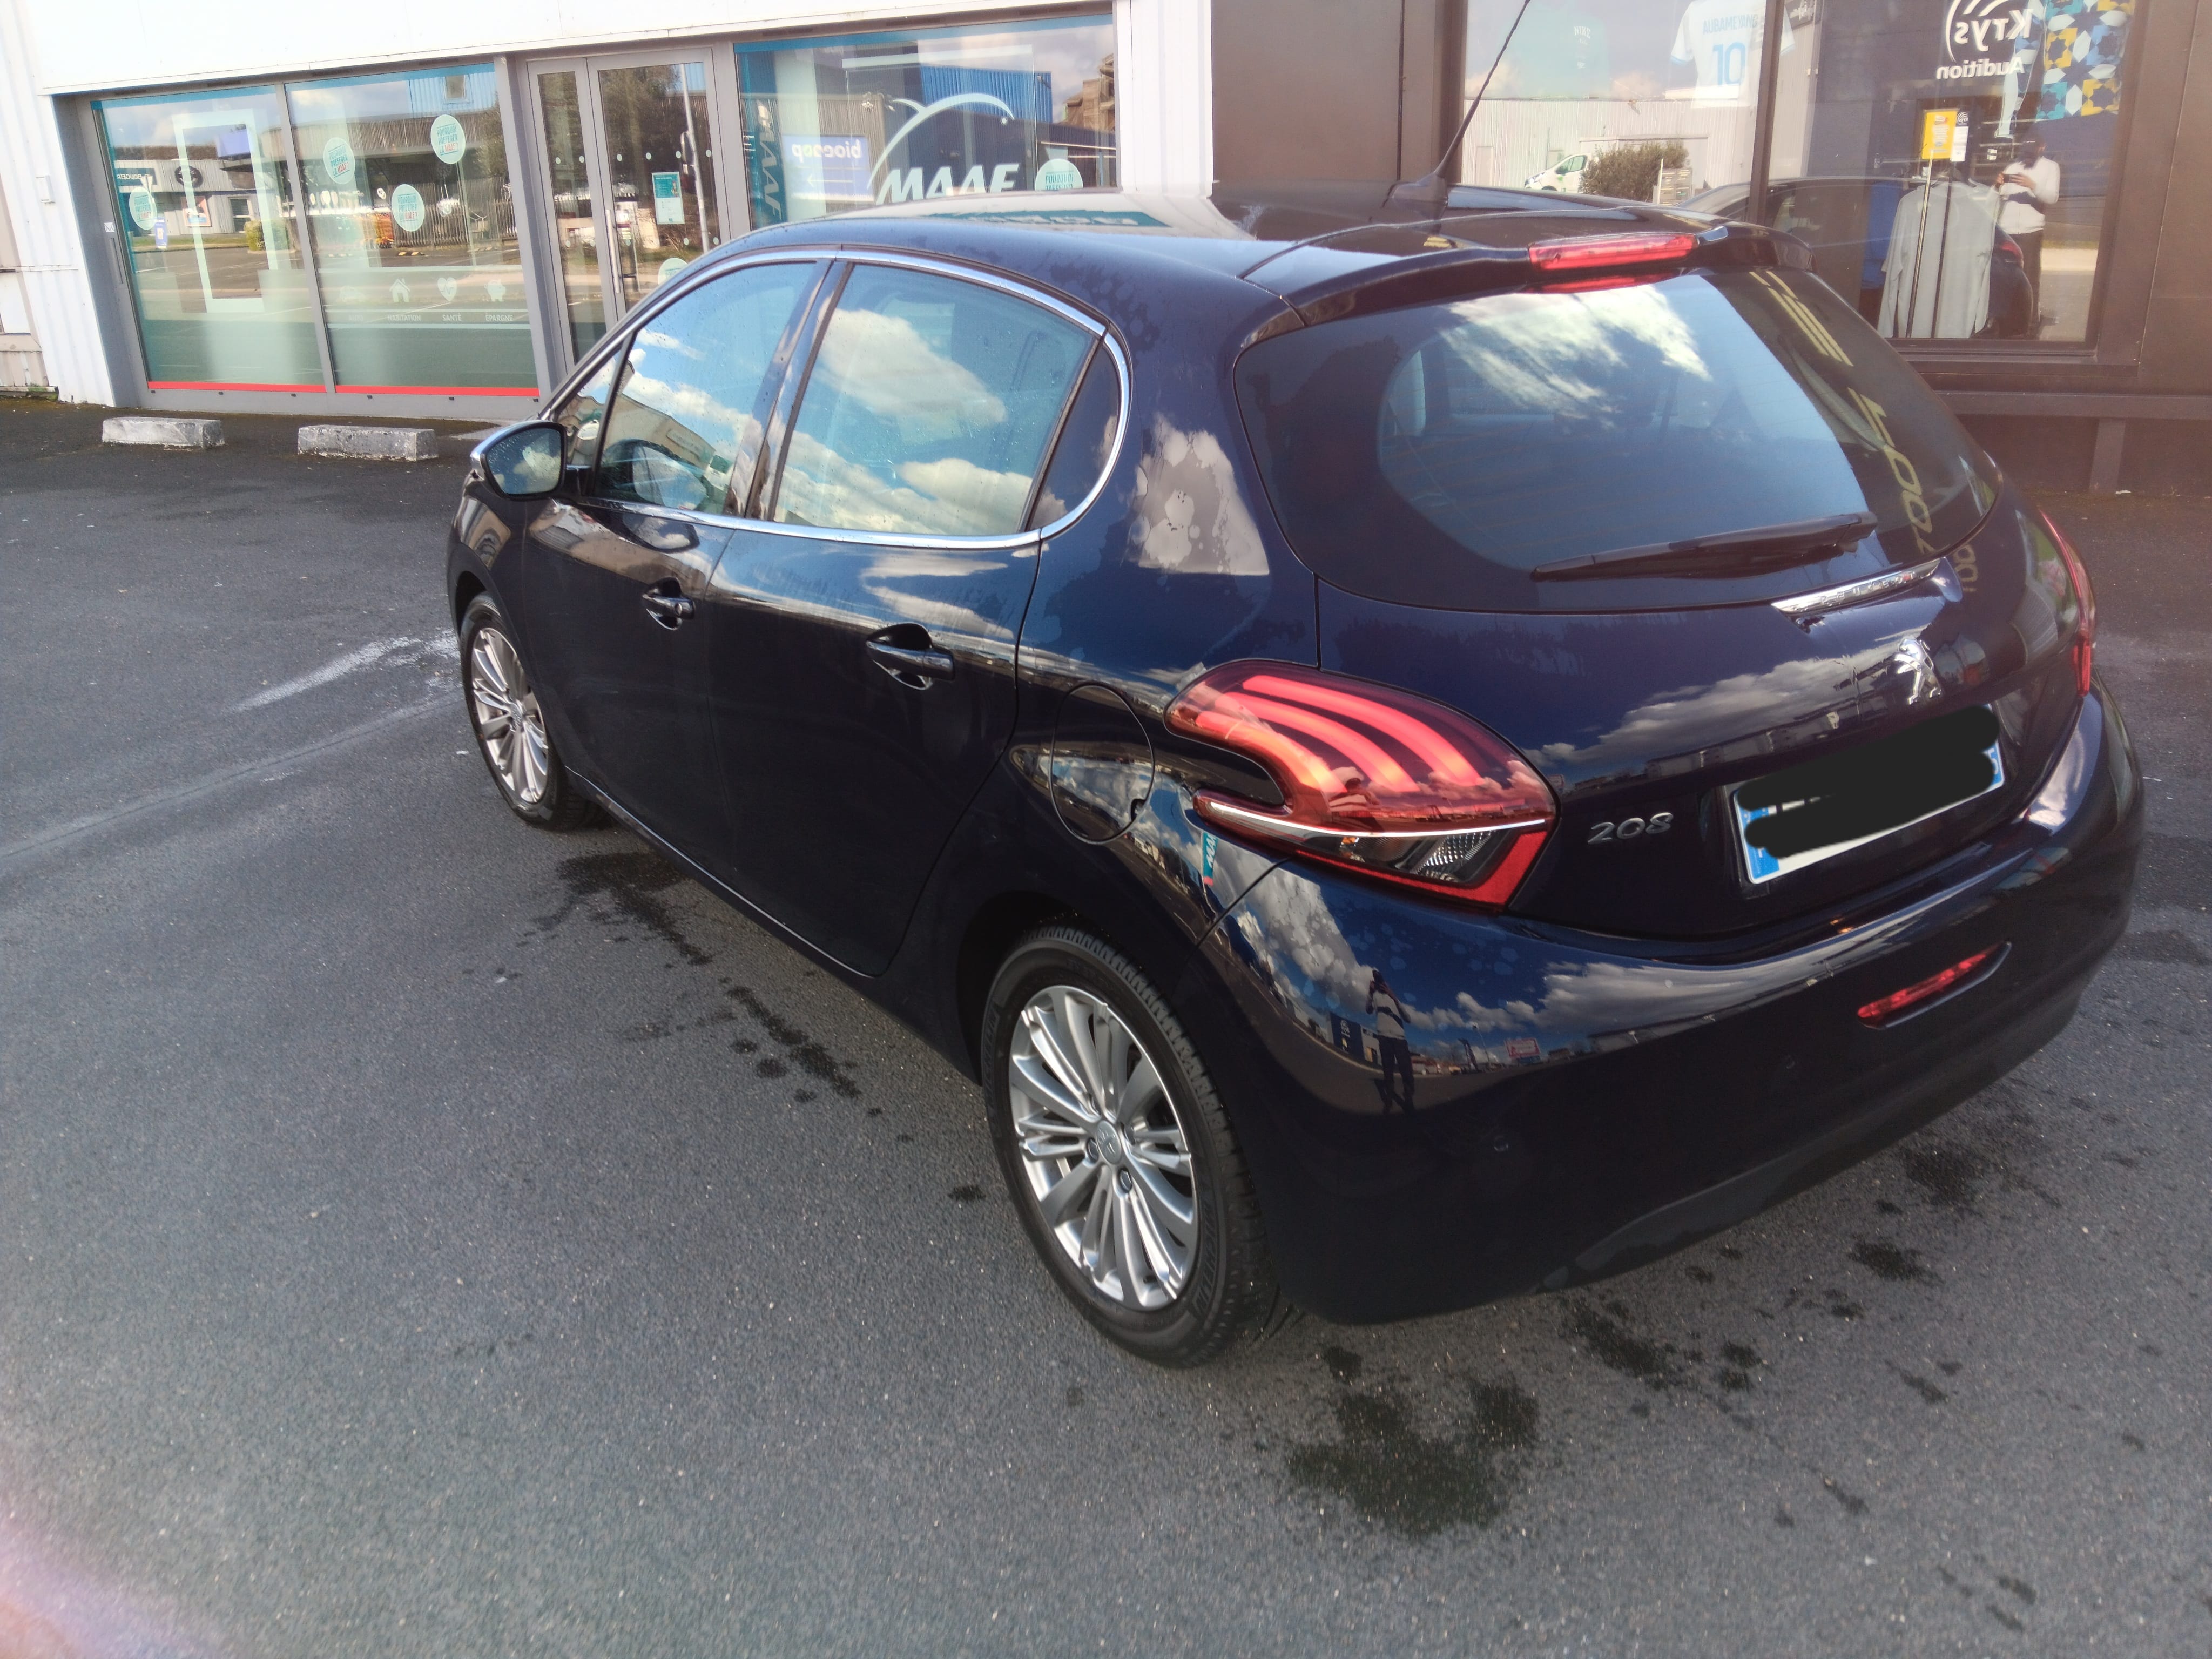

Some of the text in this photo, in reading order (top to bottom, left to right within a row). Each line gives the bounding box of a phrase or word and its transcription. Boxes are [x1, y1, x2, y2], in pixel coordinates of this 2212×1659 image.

[1702, 14, 1759, 35] AUBAMEYANG
[1712, 42, 1746, 86] 10
[875, 164, 1019, 205] MAAF
[1045, 173, 1074, 184] POURQUOI
[388, 314, 421, 322] HABITATION
[442, 312, 462, 322] SANTÉ
[485, 312, 514, 322] ÉPARGNE
[1587, 812, 1674, 844] 208
